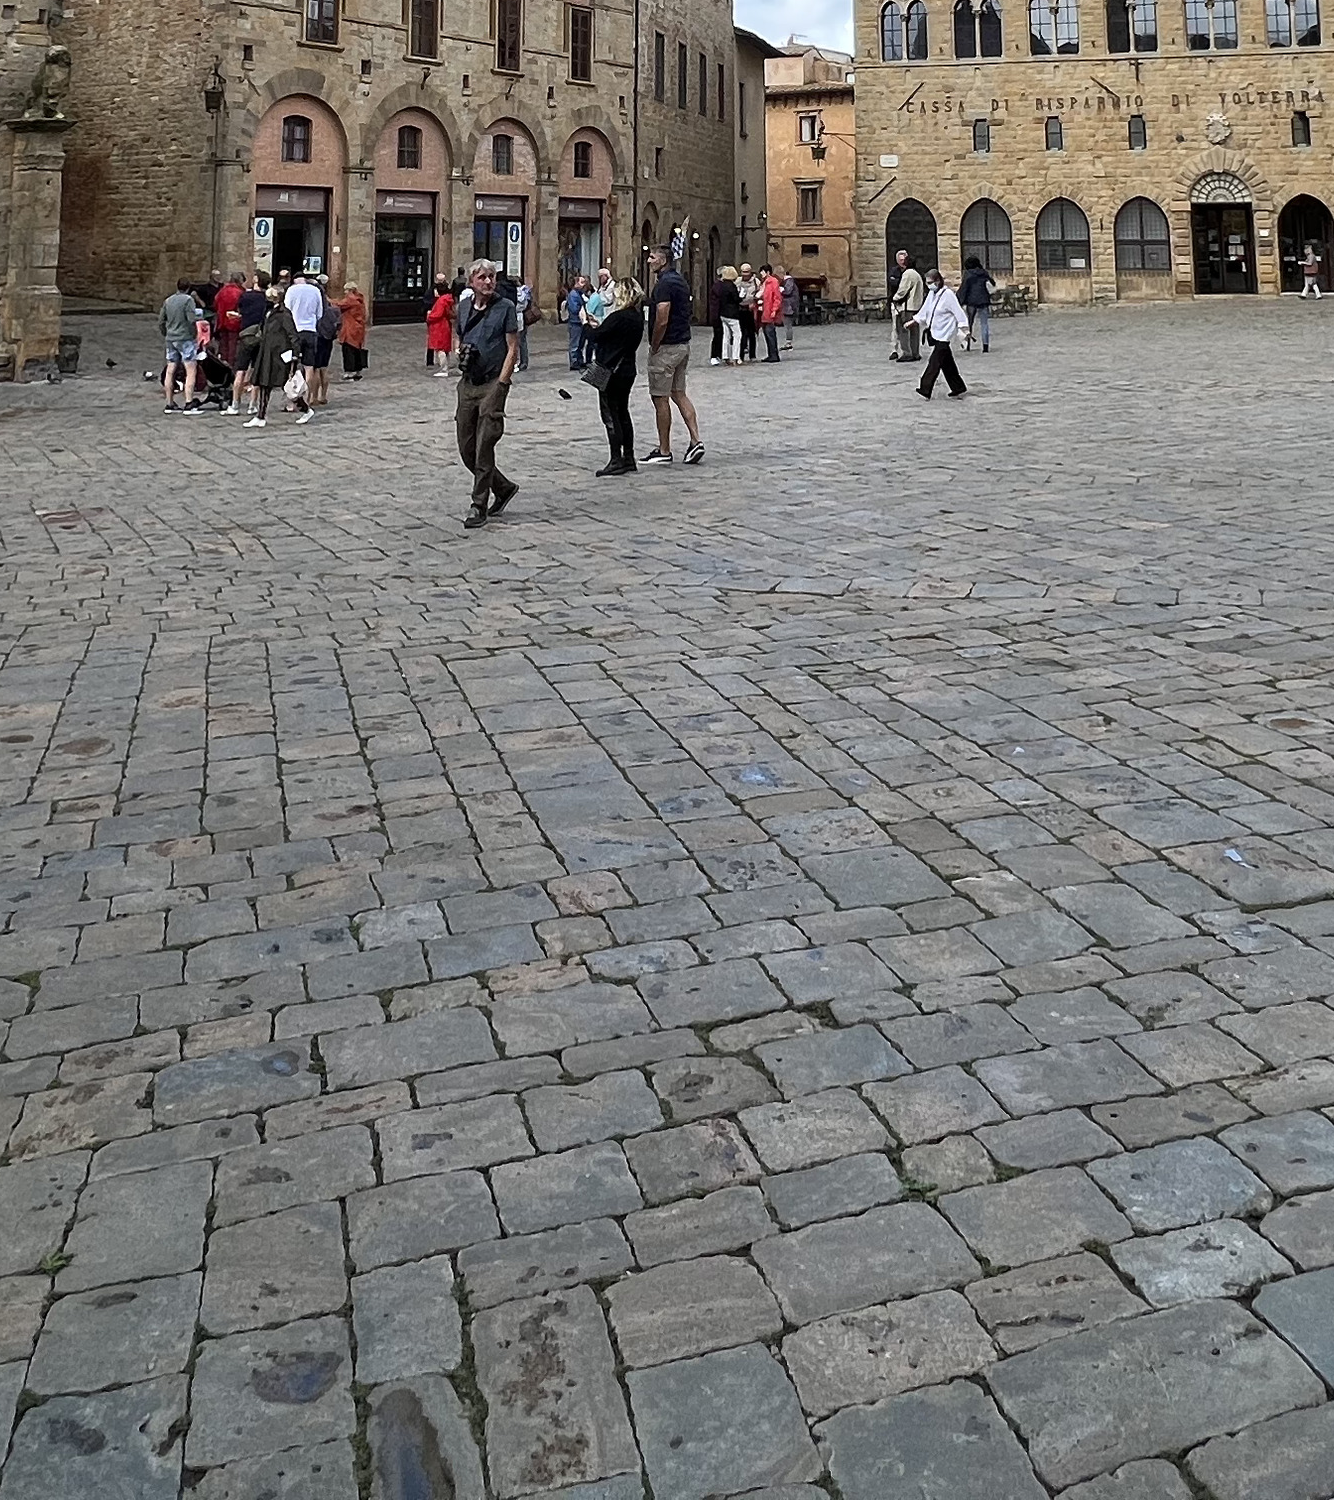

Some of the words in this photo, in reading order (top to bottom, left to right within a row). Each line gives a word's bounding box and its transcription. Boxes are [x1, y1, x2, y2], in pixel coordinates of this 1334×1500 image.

[906, 99, 966, 114] CASSA
[991, 98, 1010, 112] DI
[1035, 94, 1144, 111] RISPARMIO
[1171, 93, 1192, 108] DI
[1218, 90, 1326, 106] VOLTERRA
